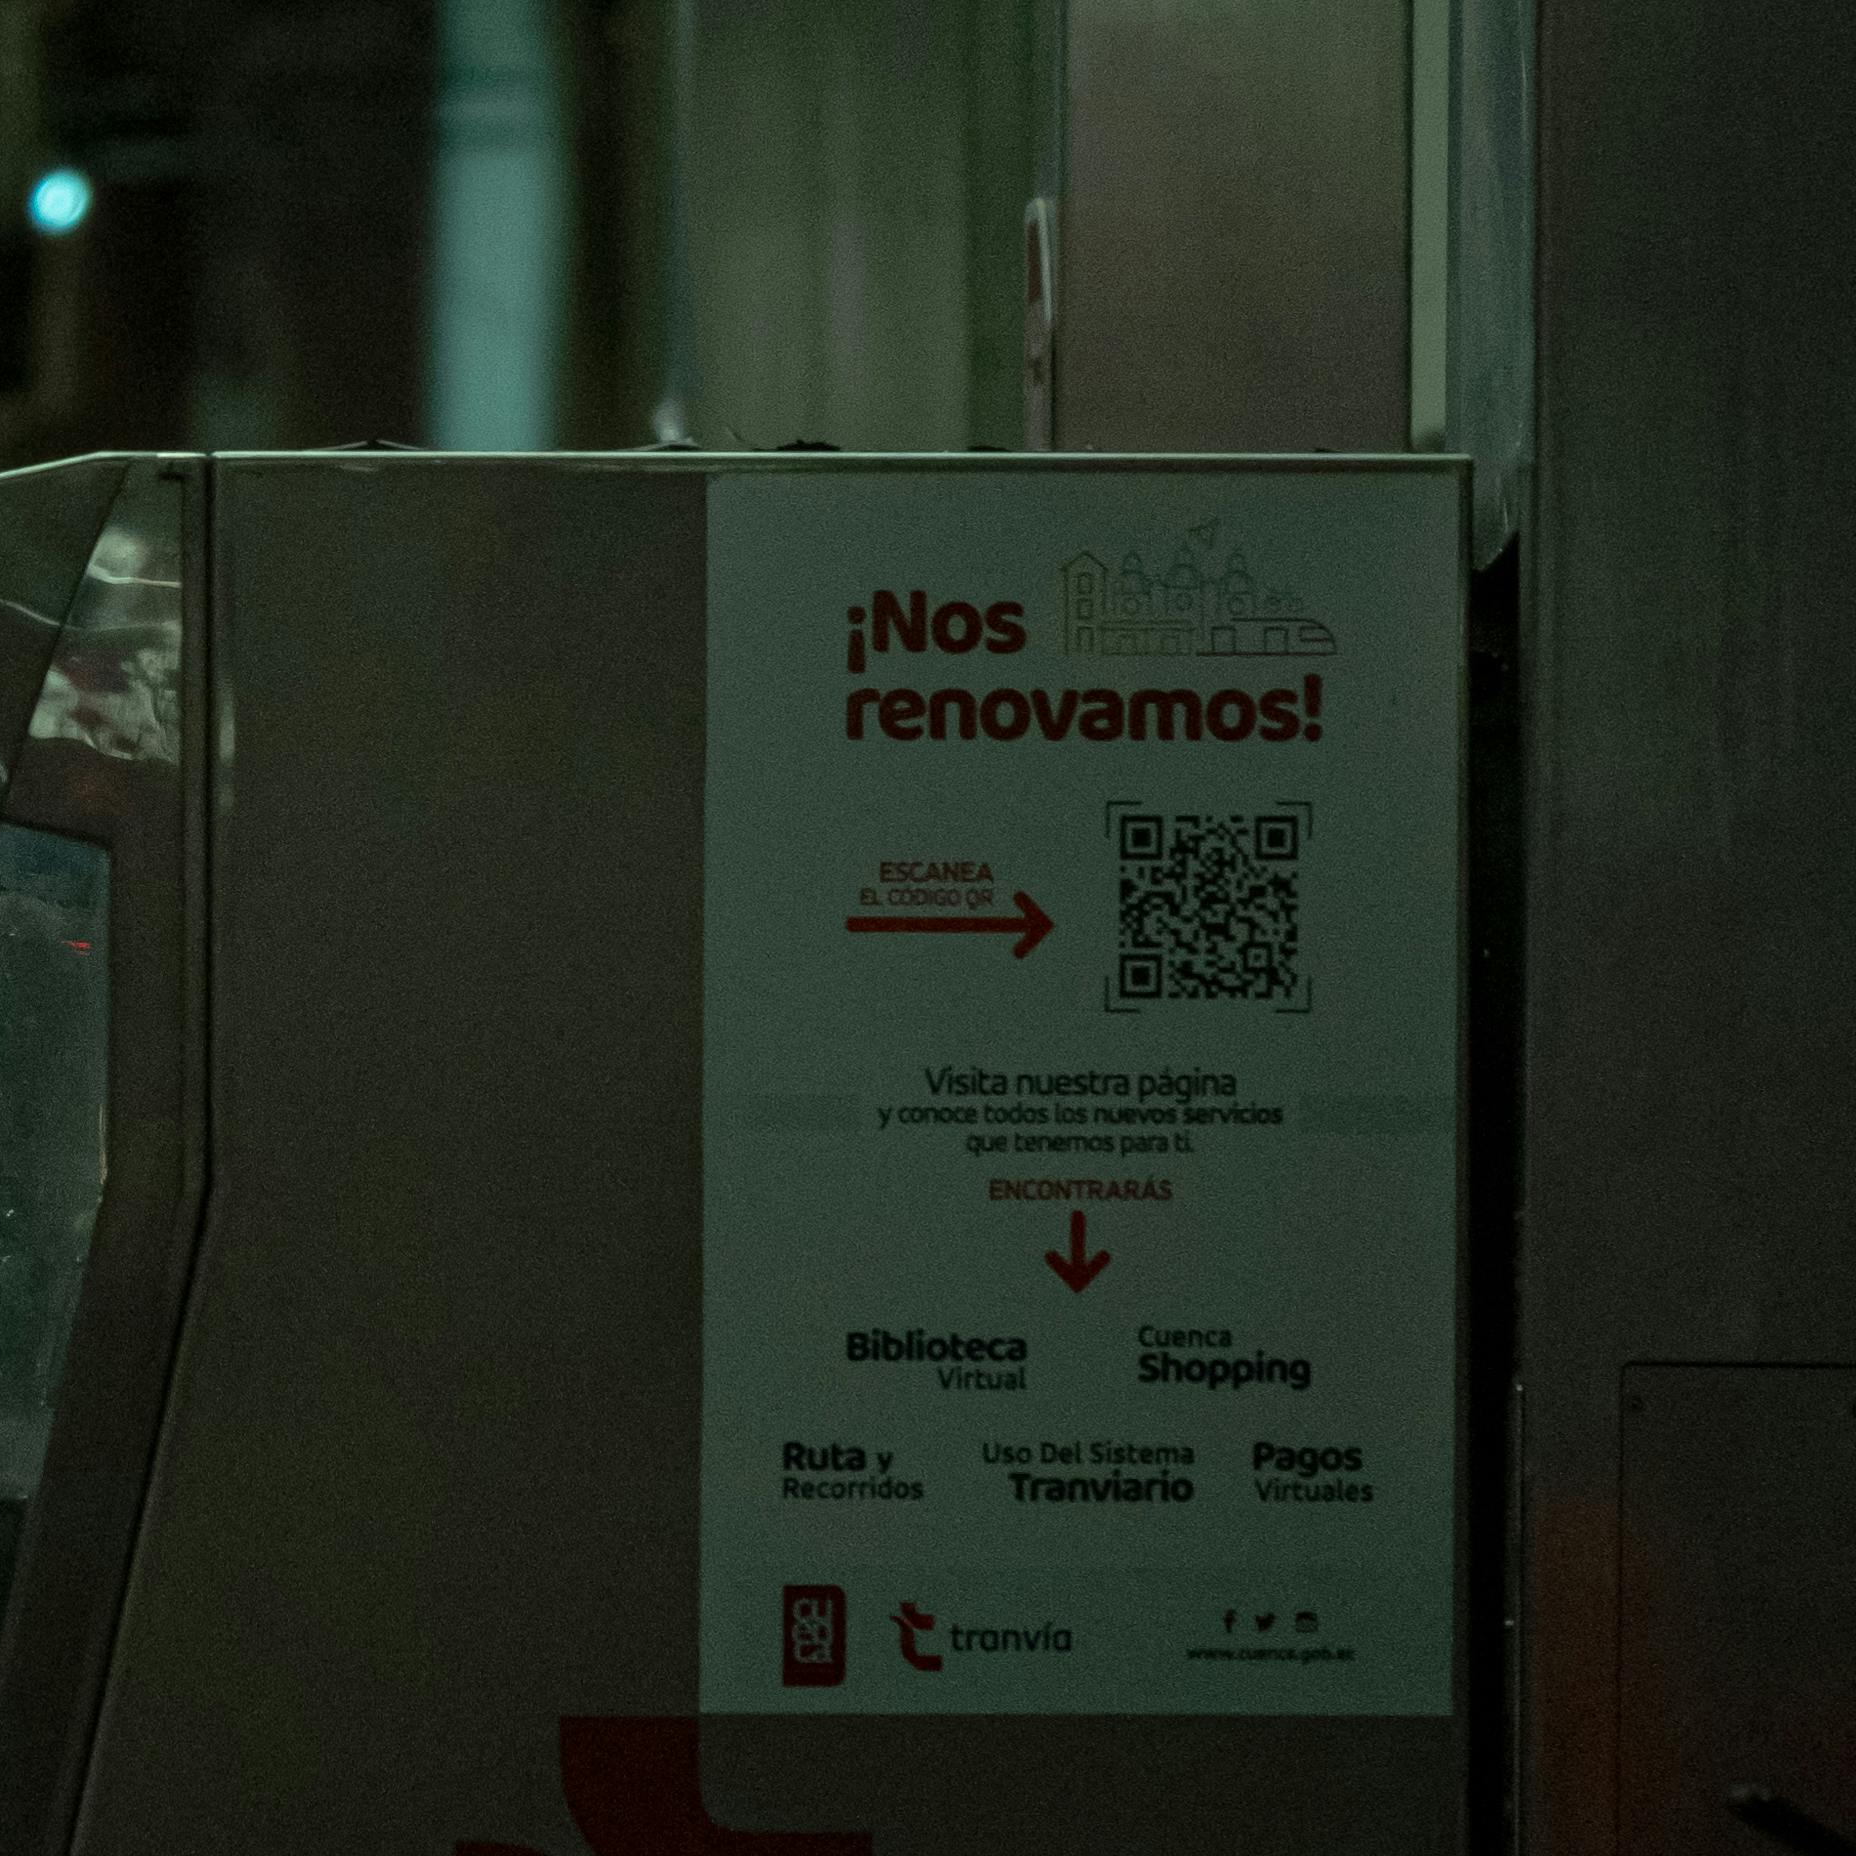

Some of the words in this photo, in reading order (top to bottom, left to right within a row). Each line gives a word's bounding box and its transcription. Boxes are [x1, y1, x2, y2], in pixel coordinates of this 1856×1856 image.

[847, 589, 1027, 672] ¡Nos
[846, 673, 1323, 743] renovamos!
[879, 860, 994, 884] ESCANEA
[858, 887, 882, 907] EL
[965, 888, 994, 911] QR
[924, 1065, 1009, 1097] Visita
[1015, 1070, 1131, 1097] nuestra
[1137, 1066, 1238, 1102] página
[877, 1107, 893, 1130] y
[897, 1106, 979, 1125] conoce
[983, 1102, 1050, 1125] todos
[1054, 1102, 1089, 1125] los
[1093, 1105, 1180, 1125] nuevos
[1180, 1101, 1284, 1126] servicios
[965, 1134, 1009, 1157] que
[1013, 1133, 1116, 1154] tenemos
[1119, 1134, 1170, 1158] para
[988, 1178, 1173, 1202] ENCONTRARÁS
[846, 1328, 1028, 1363] Biblioteca
[1137, 1324, 1233, 1349] Cuenca
[937, 1366, 1027, 1391] Virtual
[1138, 1349, 1312, 1392] Shopping
[782, 1441, 867, 1472] Ruta
[876, 1452, 894, 1474] y
[982, 1442, 1033, 1465] Uso
[1040, 1441, 1082, 1466] Del
[1089, 1440, 1195, 1466] Sistema
[1252, 1440, 1363, 1477] Pagos
[782, 1476, 925, 1501] Recorridos
[1008, 1468, 1195, 1504] Tranviario
[1254, 1478, 1374, 1503] Virtuales
[949, 1621, 1073, 1653] tranvía
